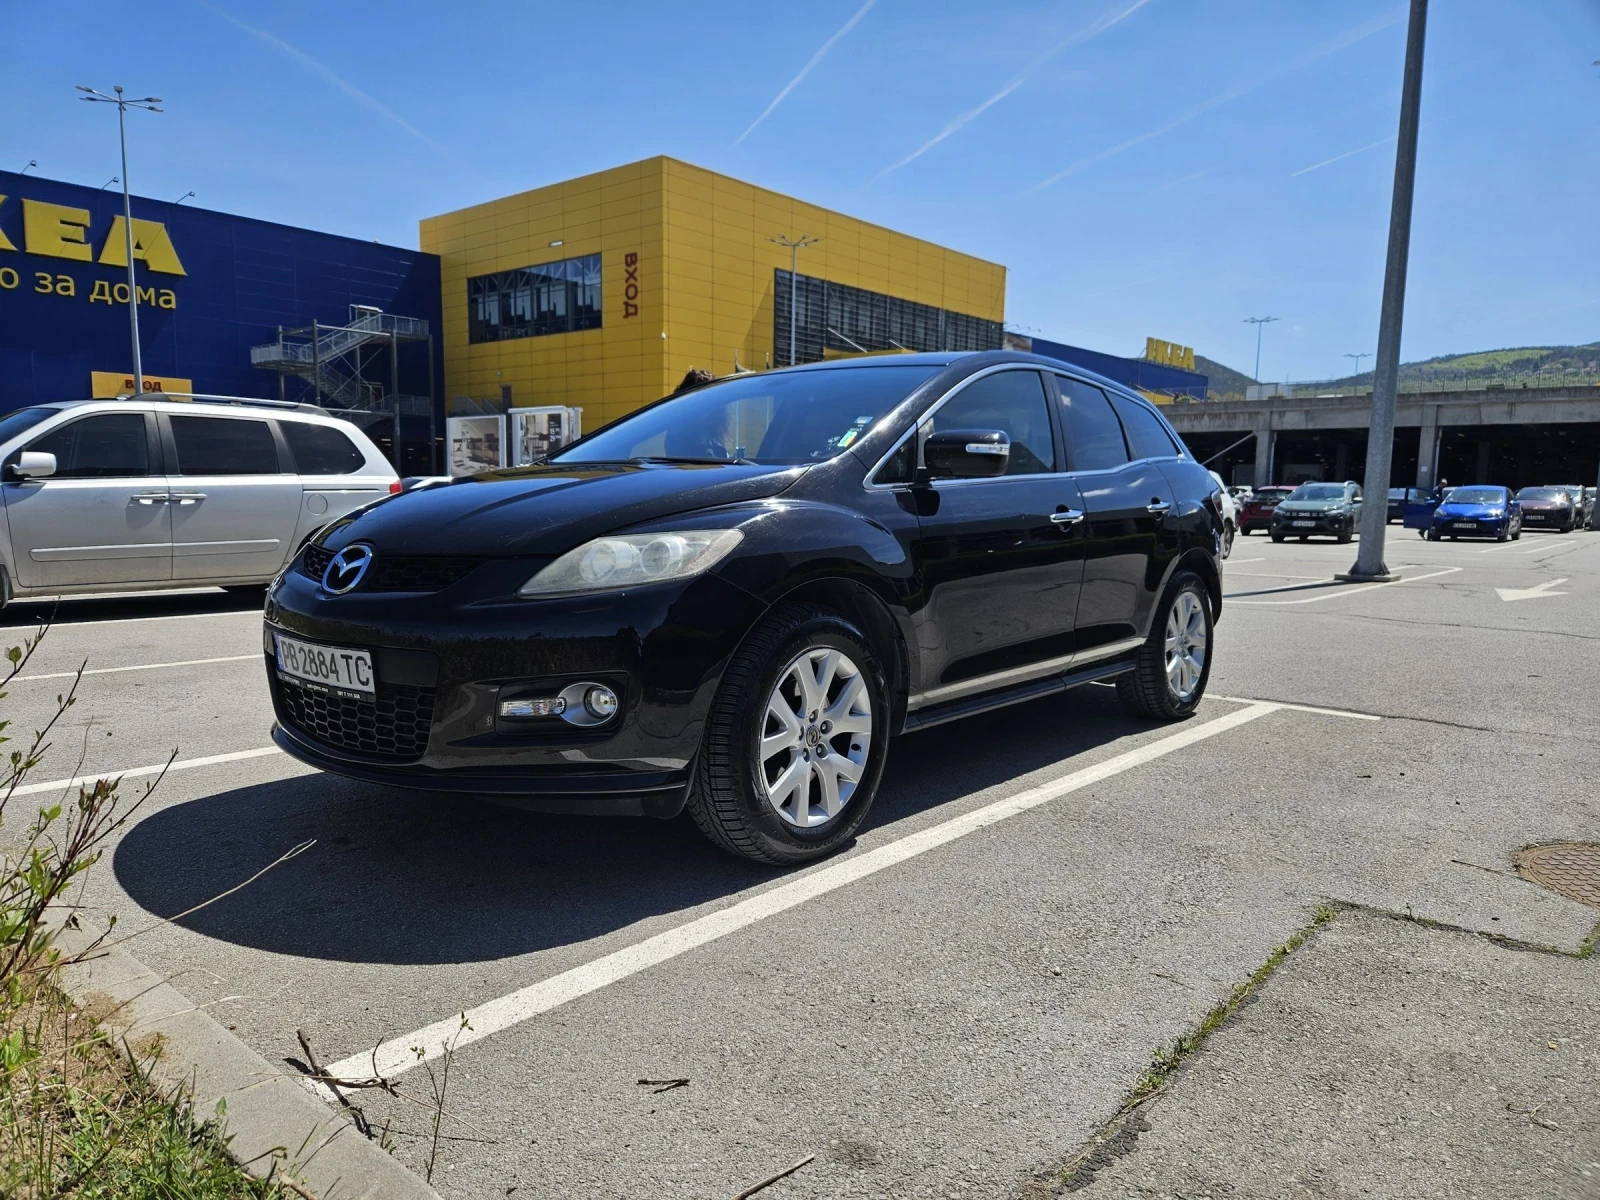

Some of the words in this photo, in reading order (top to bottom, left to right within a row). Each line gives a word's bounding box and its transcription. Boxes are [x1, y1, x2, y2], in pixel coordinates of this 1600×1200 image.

[34, 272, 75, 297] за
[89, 279, 177, 310] дома
[623, 252, 639, 319] ВХОД
[1146, 337, 1196, 371] IKEA
[125, 379, 162, 392] ВОД
[298, 646, 340, 683] 2884
[340, 653, 370, 687] TC
